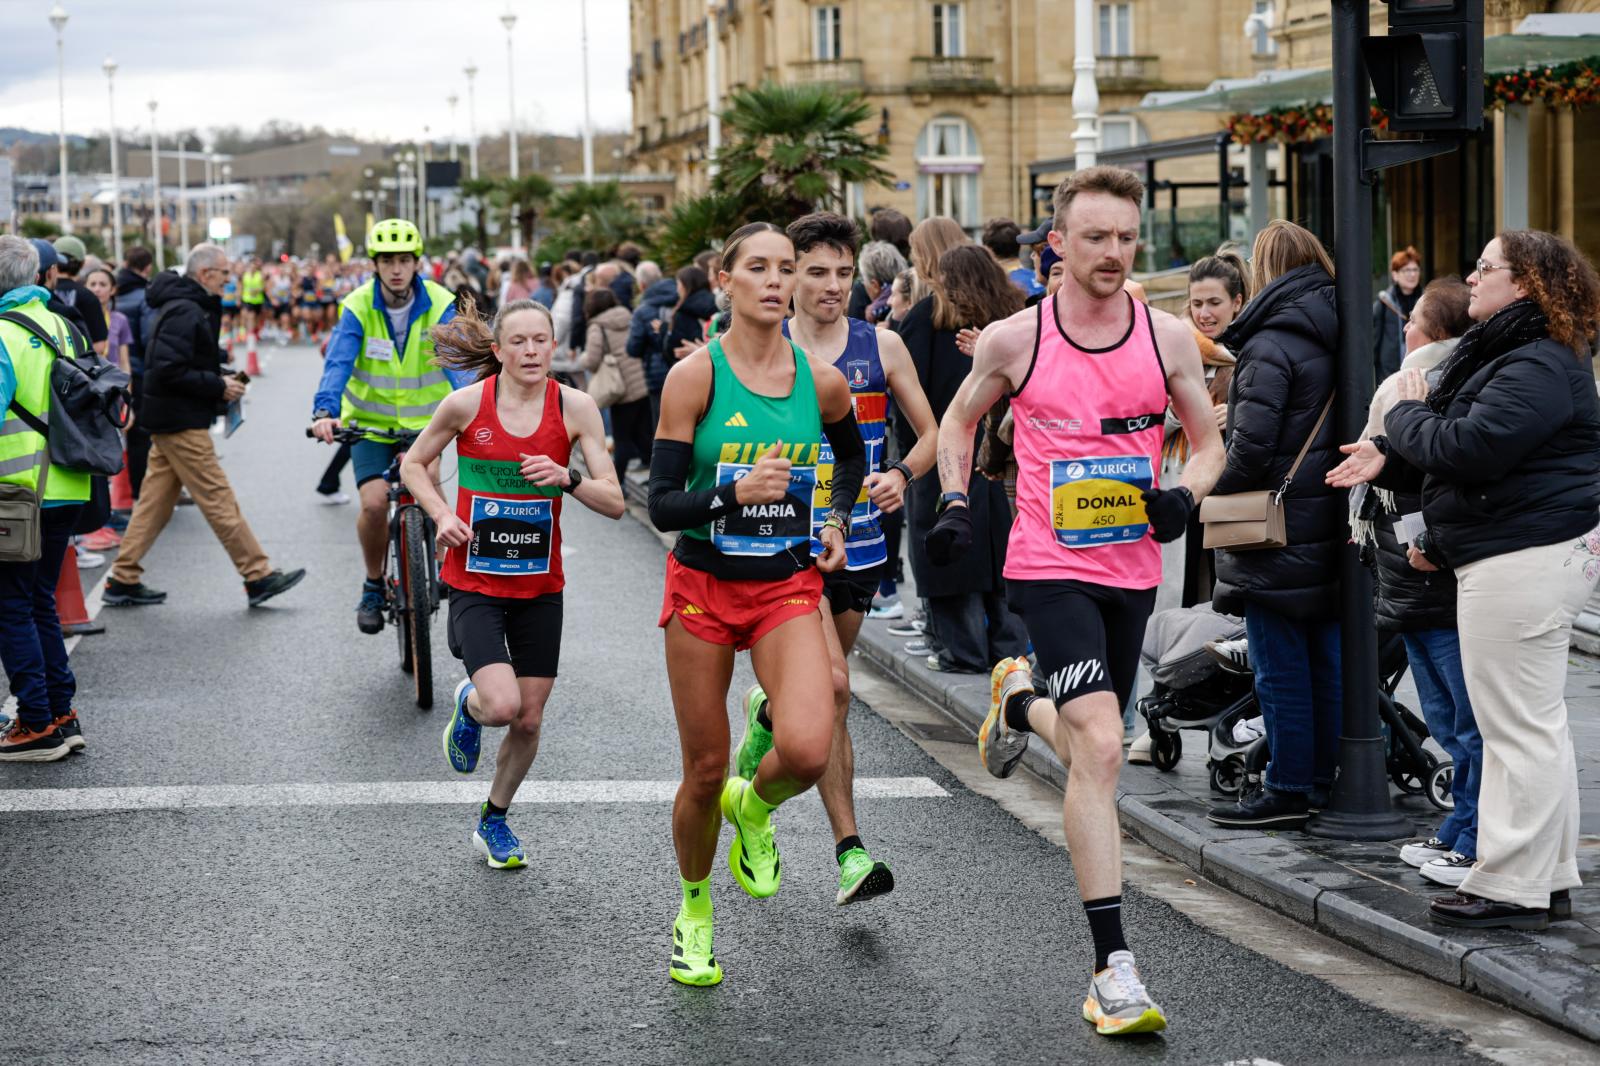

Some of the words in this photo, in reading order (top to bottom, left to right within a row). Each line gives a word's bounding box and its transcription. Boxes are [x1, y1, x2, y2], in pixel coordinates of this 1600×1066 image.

[471, 463, 486, 473] LES
[1091, 464, 1136, 474] ZURICH
[1077, 495, 1136, 510] DONAL
[503, 507, 540, 516] ZURICH
[743, 505, 796, 517] MARIA
[1092, 515, 1116, 526] 450
[759, 525, 773, 536] 53
[490, 532, 540, 544] LOUISE
[506, 549, 519, 559] 52
